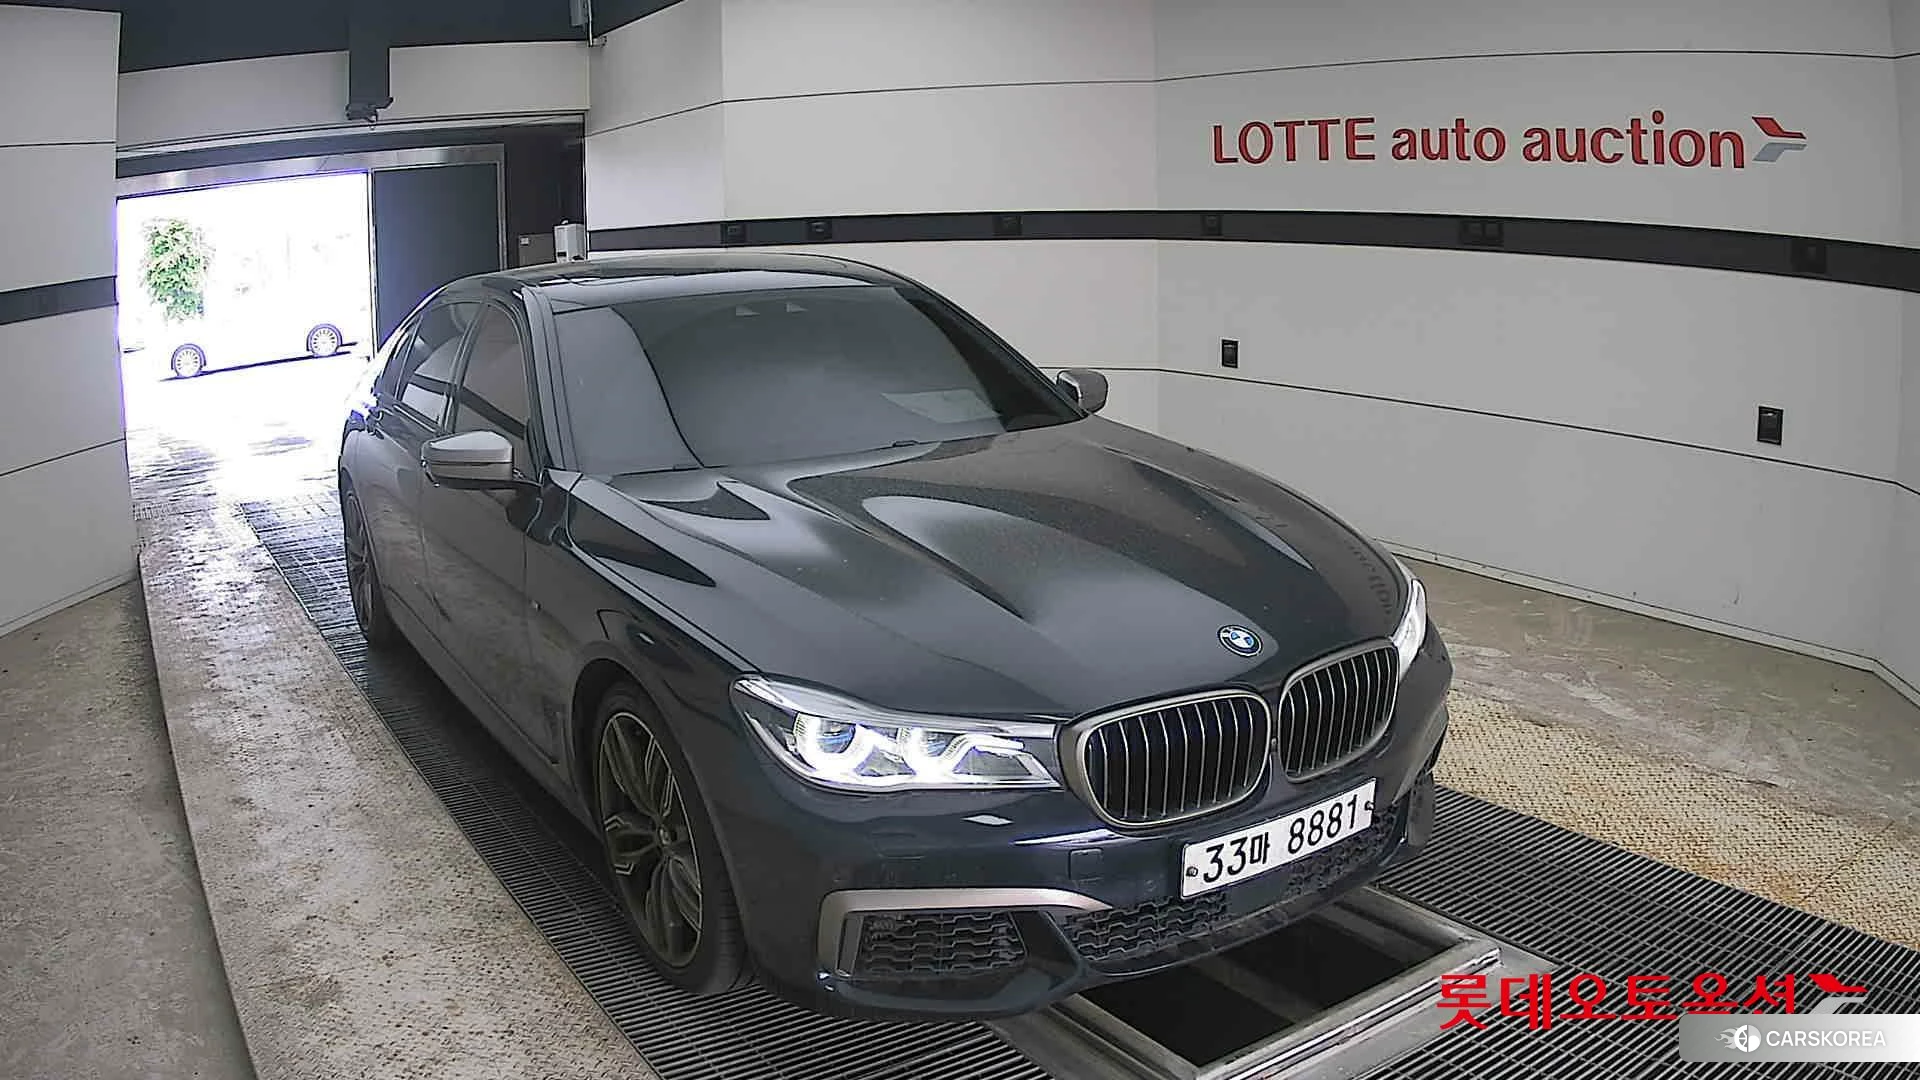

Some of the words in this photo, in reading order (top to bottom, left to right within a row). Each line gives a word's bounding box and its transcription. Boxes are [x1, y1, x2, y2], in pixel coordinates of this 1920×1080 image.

[1212, 116, 1376, 164] LOTTE
[1391, 118, 1507, 162] auto
[1522, 110, 1746, 169] auction
[1202, 831, 1271, 883] 33마
[1287, 794, 1358, 854] 8881
